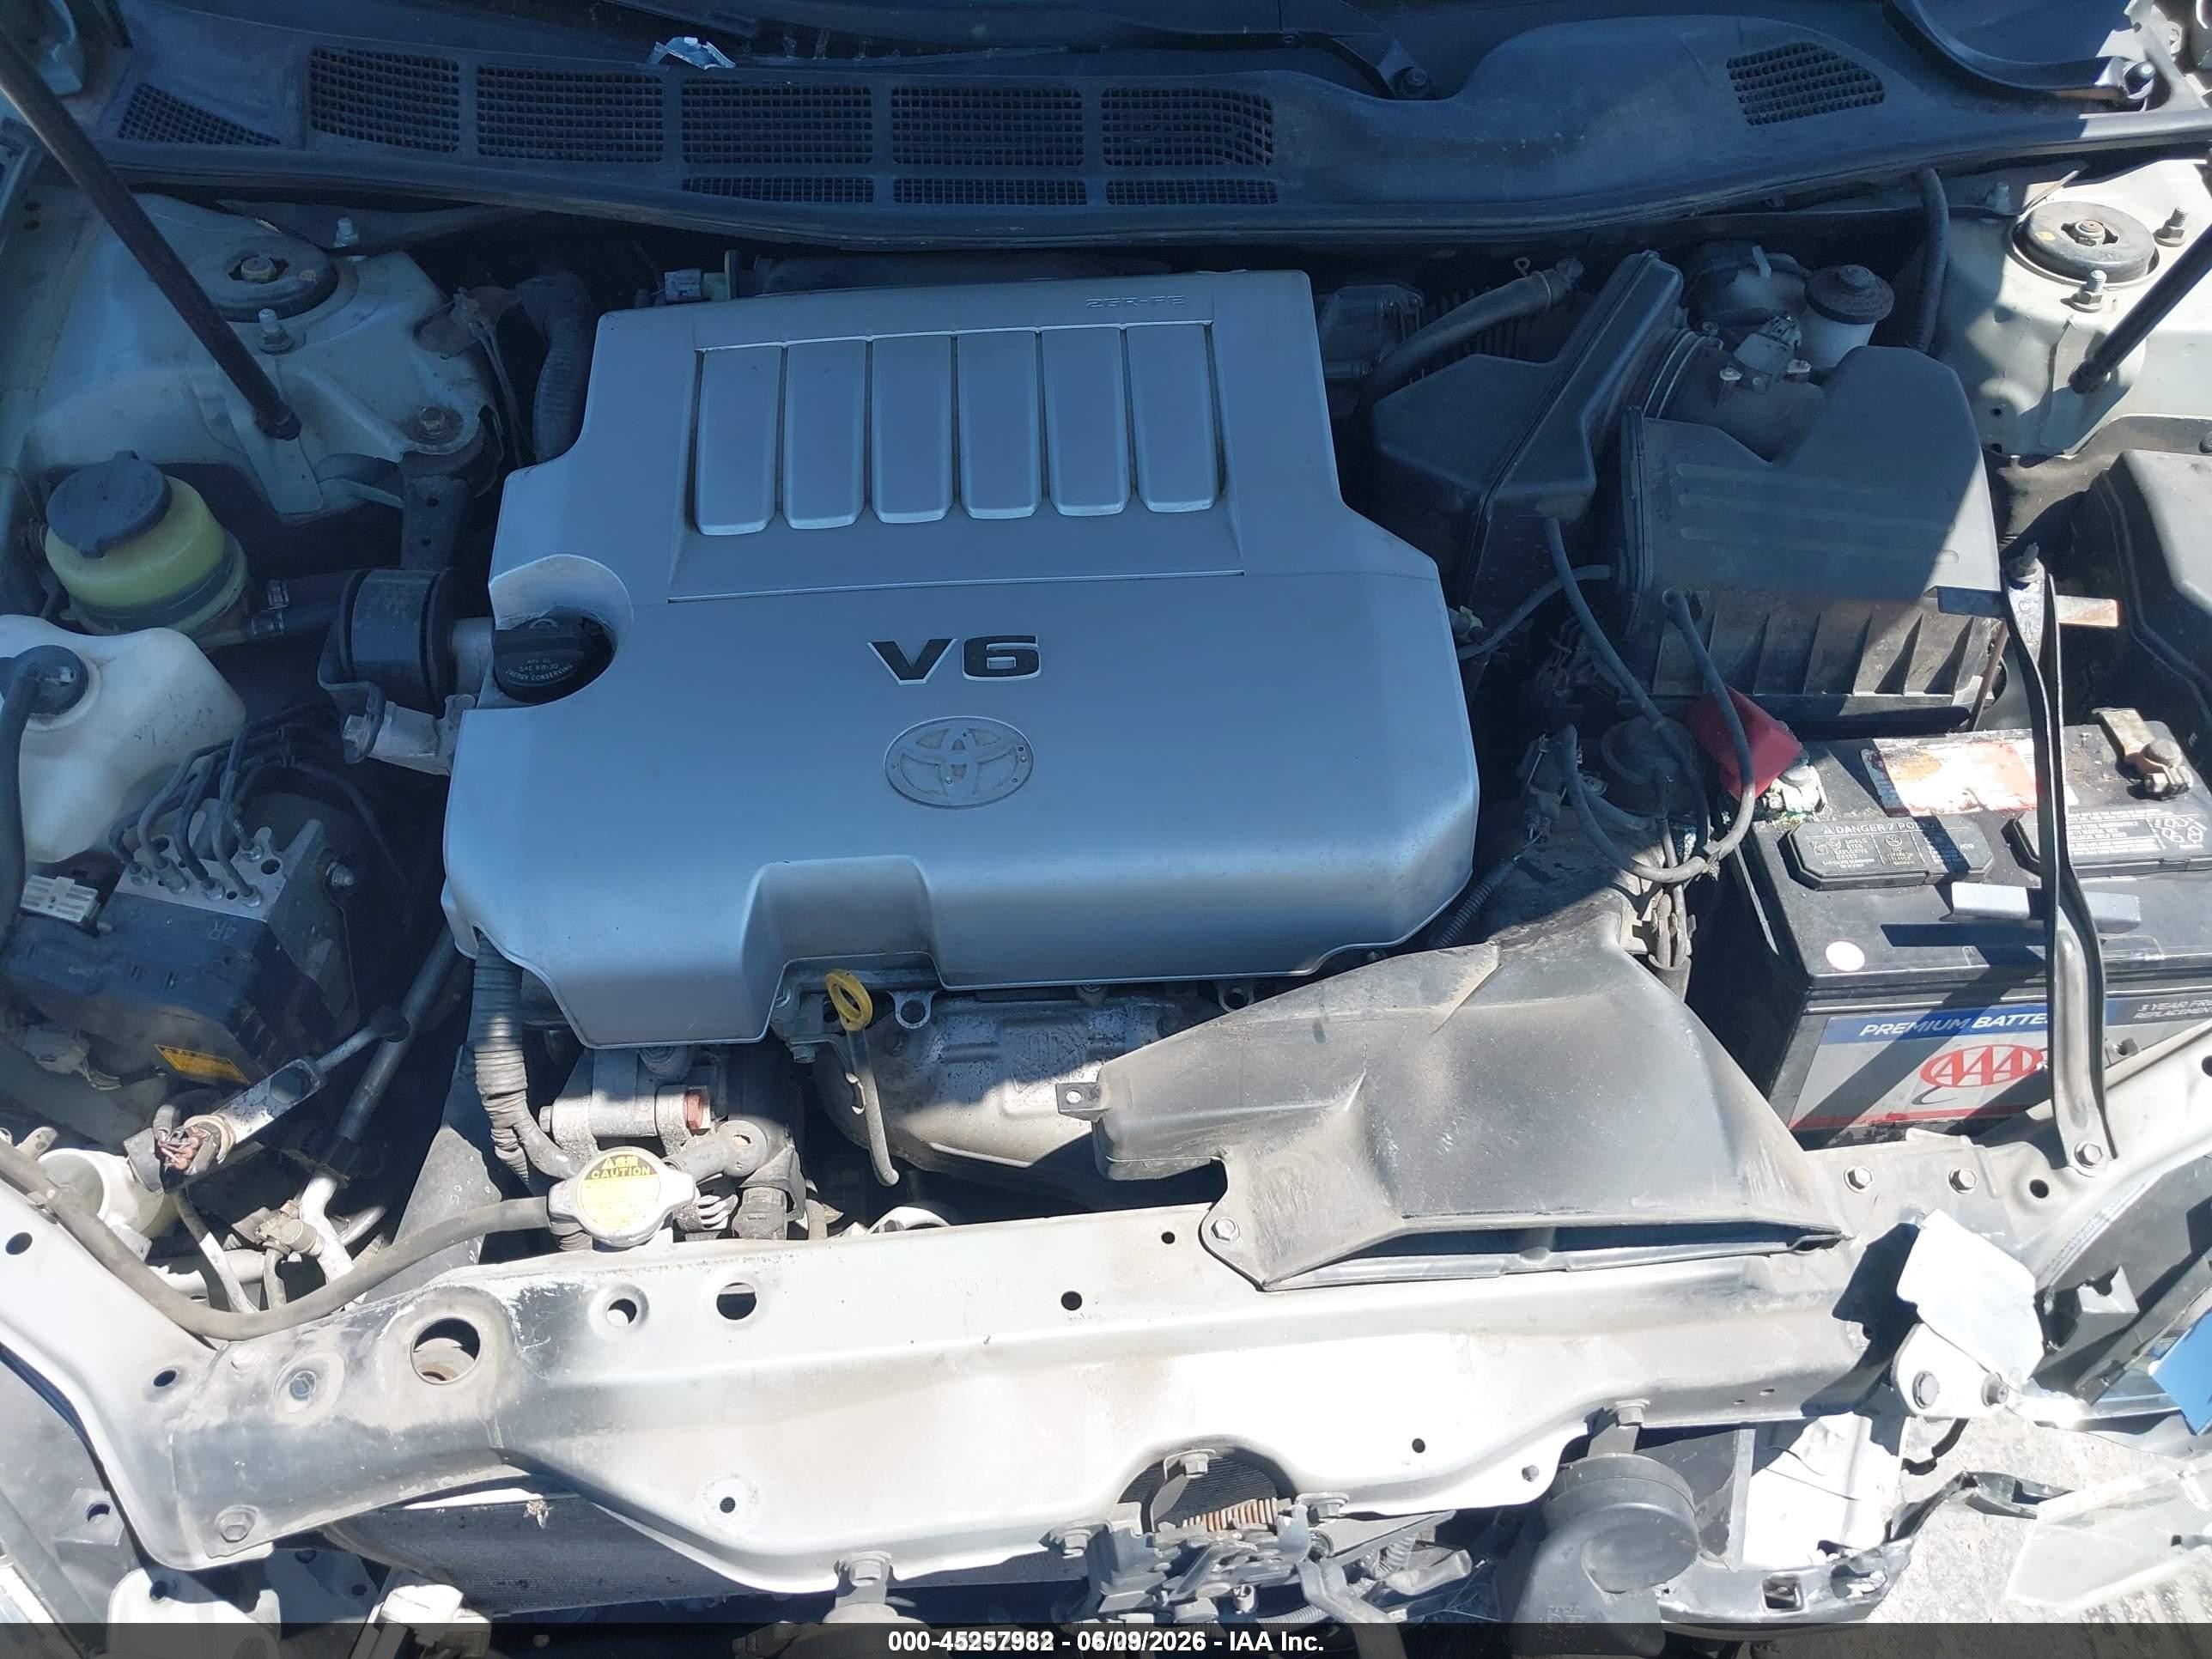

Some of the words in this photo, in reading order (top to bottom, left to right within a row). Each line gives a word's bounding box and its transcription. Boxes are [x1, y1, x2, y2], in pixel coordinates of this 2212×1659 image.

[1085, 295, 1185, 308] 2GR-FE
[866, 635, 1042, 684] V6
[1835, 823, 1885, 834] DANGER
[1859, 1018, 1970, 1036] PREMIUM
[1972, 1013, 2048, 1030] BATTE
[1923, 1044, 2039, 1087] AAA
[591, 1166, 650, 1179] CAUTION
